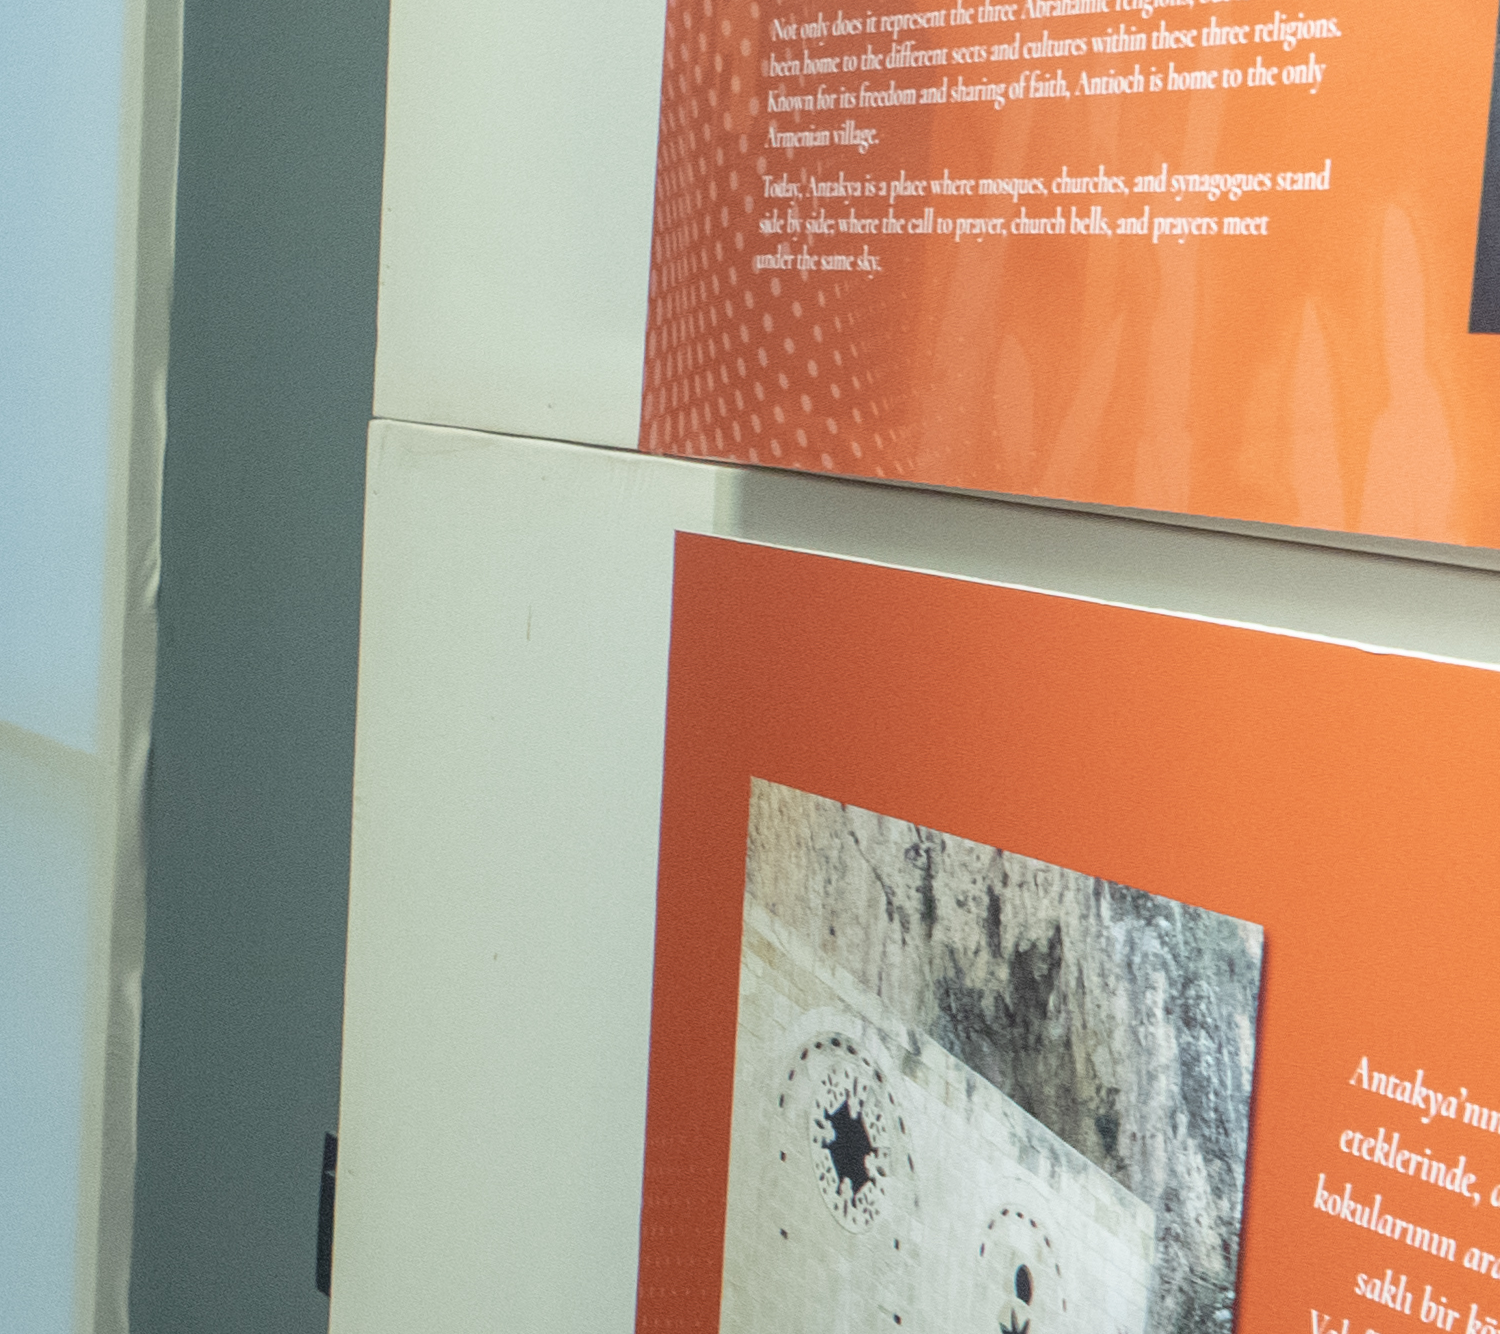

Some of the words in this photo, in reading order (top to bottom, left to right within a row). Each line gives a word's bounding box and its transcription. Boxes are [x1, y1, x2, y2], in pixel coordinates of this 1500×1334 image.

[756, 244, 794, 271] under
[796, 244, 818, 271] the
[820, 254, 855, 271] same
[856, 244, 882, 279] sky.
[1338, 1126, 1480, 1205] eteklerinde,
[1313, 1172, 1456, 1261] kokularının
[1353, 1268, 1412, 1315] saklı
[1419, 1283, 1460, 1331] bir
